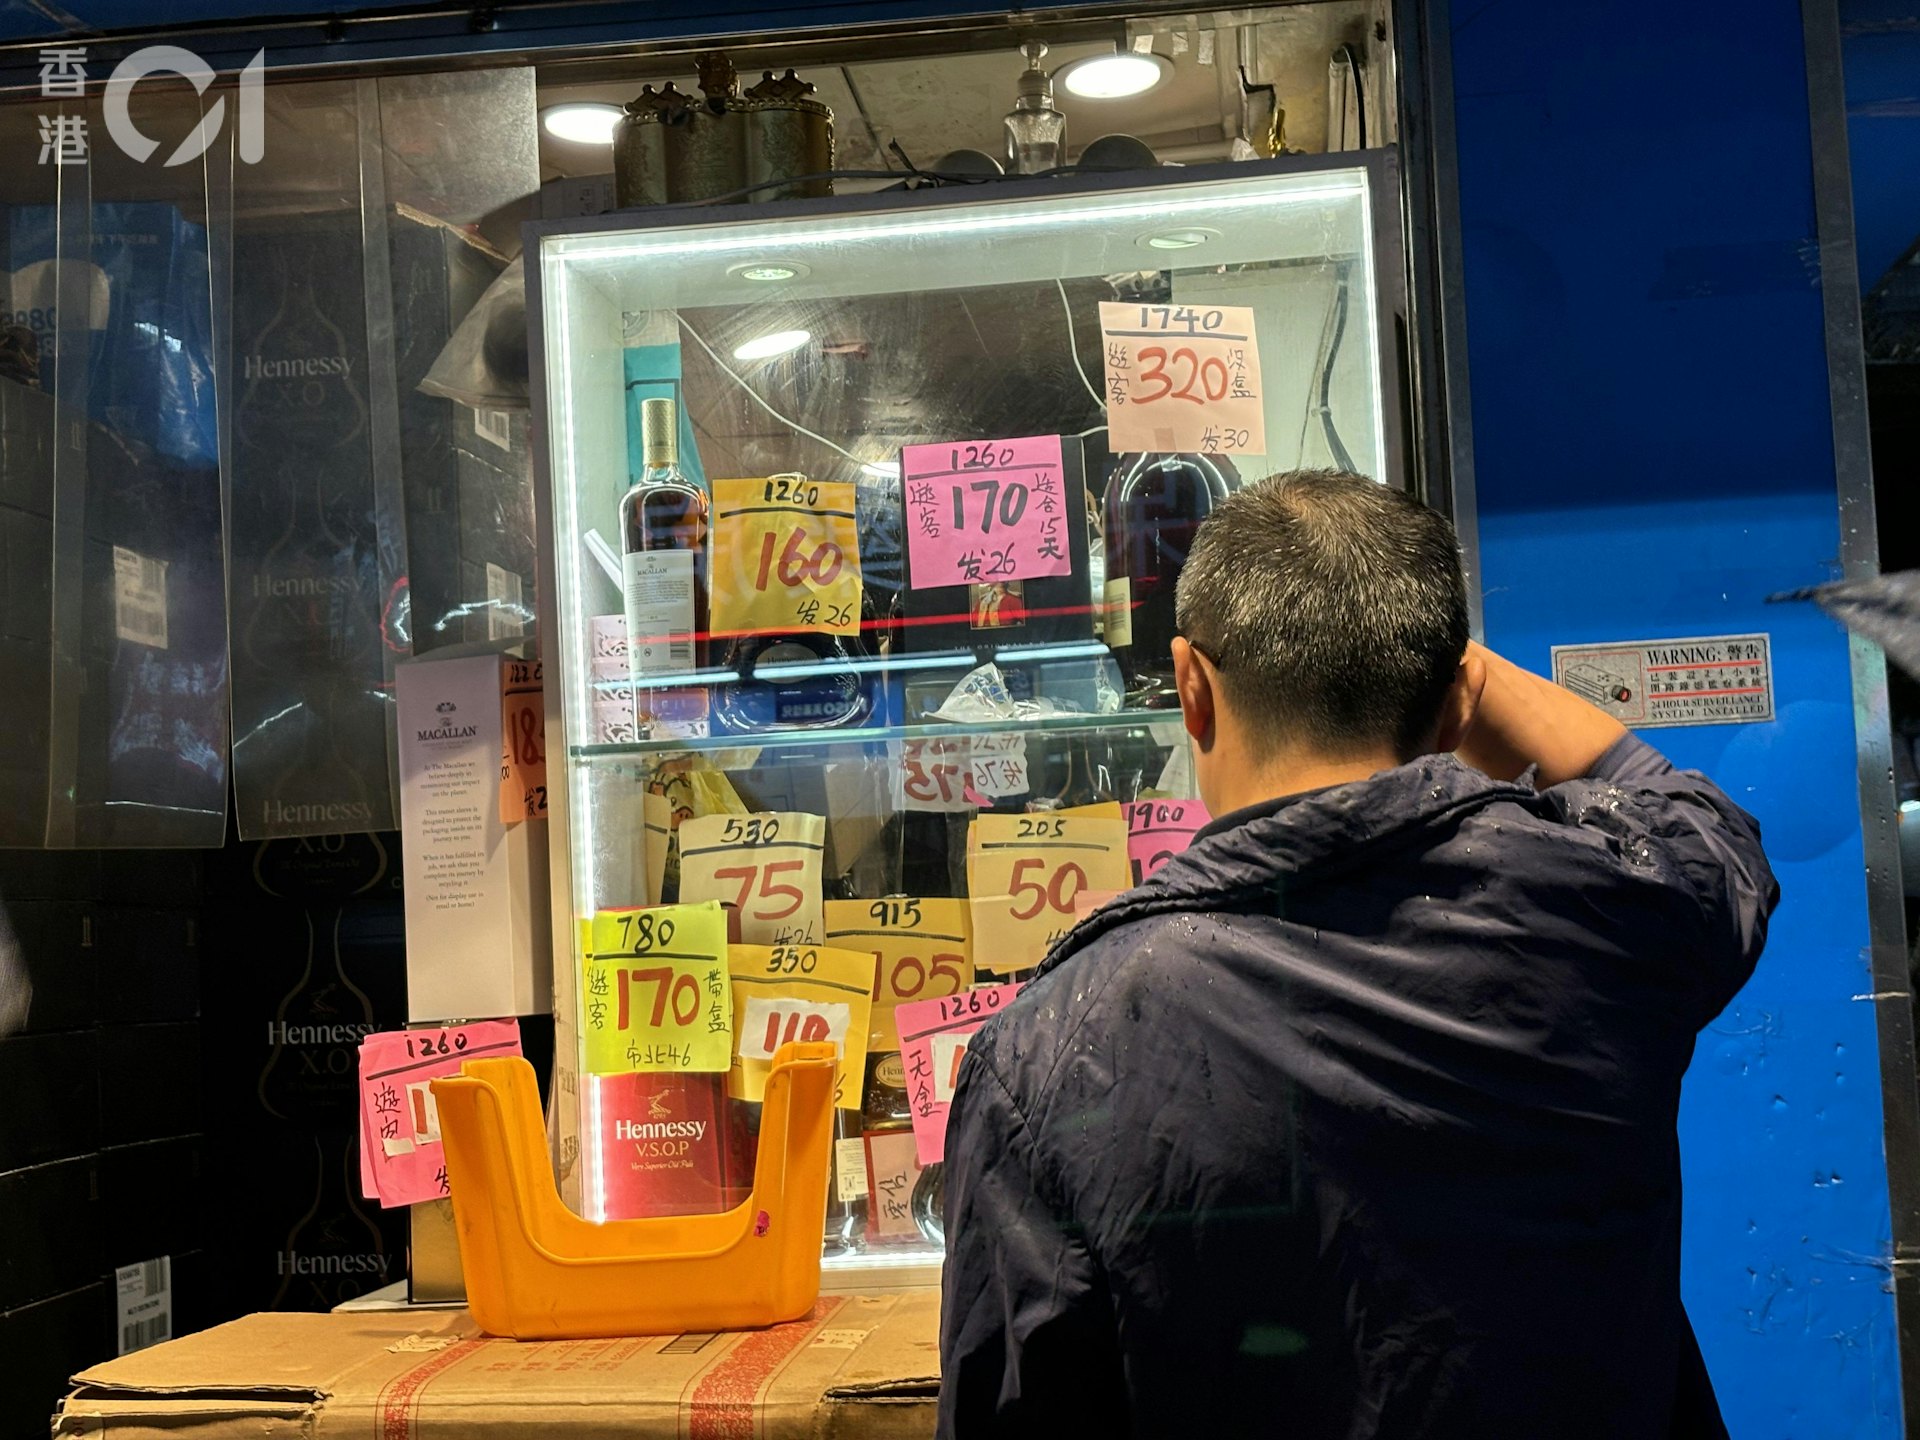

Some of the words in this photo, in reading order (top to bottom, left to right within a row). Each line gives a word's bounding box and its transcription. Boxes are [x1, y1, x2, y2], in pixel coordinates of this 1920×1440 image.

[1141, 307, 1223, 333] 1740
[244, 355, 356, 380] Hennessy
[1131, 347, 1228, 404] 320
[951, 443, 1015, 470] 1260
[764, 480, 819, 506] 1260
[953, 480, 1029, 534] 170
[755, 527, 843, 592] 160
[252, 573, 365, 598] Hennessy
[1647, 646, 1721, 665] WARNING:
[1651, 700, 1660, 710] 24
[1662, 699, 1689, 709] HOUR
[1691, 696, 1761, 707] SURVEILLANCE
[1651, 709, 1694, 719] SYSTEM
[1703, 705, 1764, 716] INSTALLED
[417, 726, 477, 741] MACALLAN
[262, 799, 375, 823] Hennessy
[422, 817, 445, 825] designed
[1128, 802, 1185, 830] 1900
[422, 827, 449, 836] packaging
[720, 818, 780, 845] 530
[1017, 819, 1067, 838] 205
[469, 860, 480, 868] you
[713, 860, 804, 921] 75
[1009, 858, 1088, 921] 50
[870, 899, 922, 928] 915
[617, 913, 675, 953] 780
[766, 947, 817, 974] 350
[871, 952, 965, 1002] 105
[617, 967, 700, 1030] 170
[940, 990, 999, 1020] 1260
[404, 1031, 468, 1058] 1260
[616, 1119, 707, 1141] Hennessy
[635, 1141, 690, 1157] V.S.O.P
[277, 1250, 392, 1278] Hennessy
